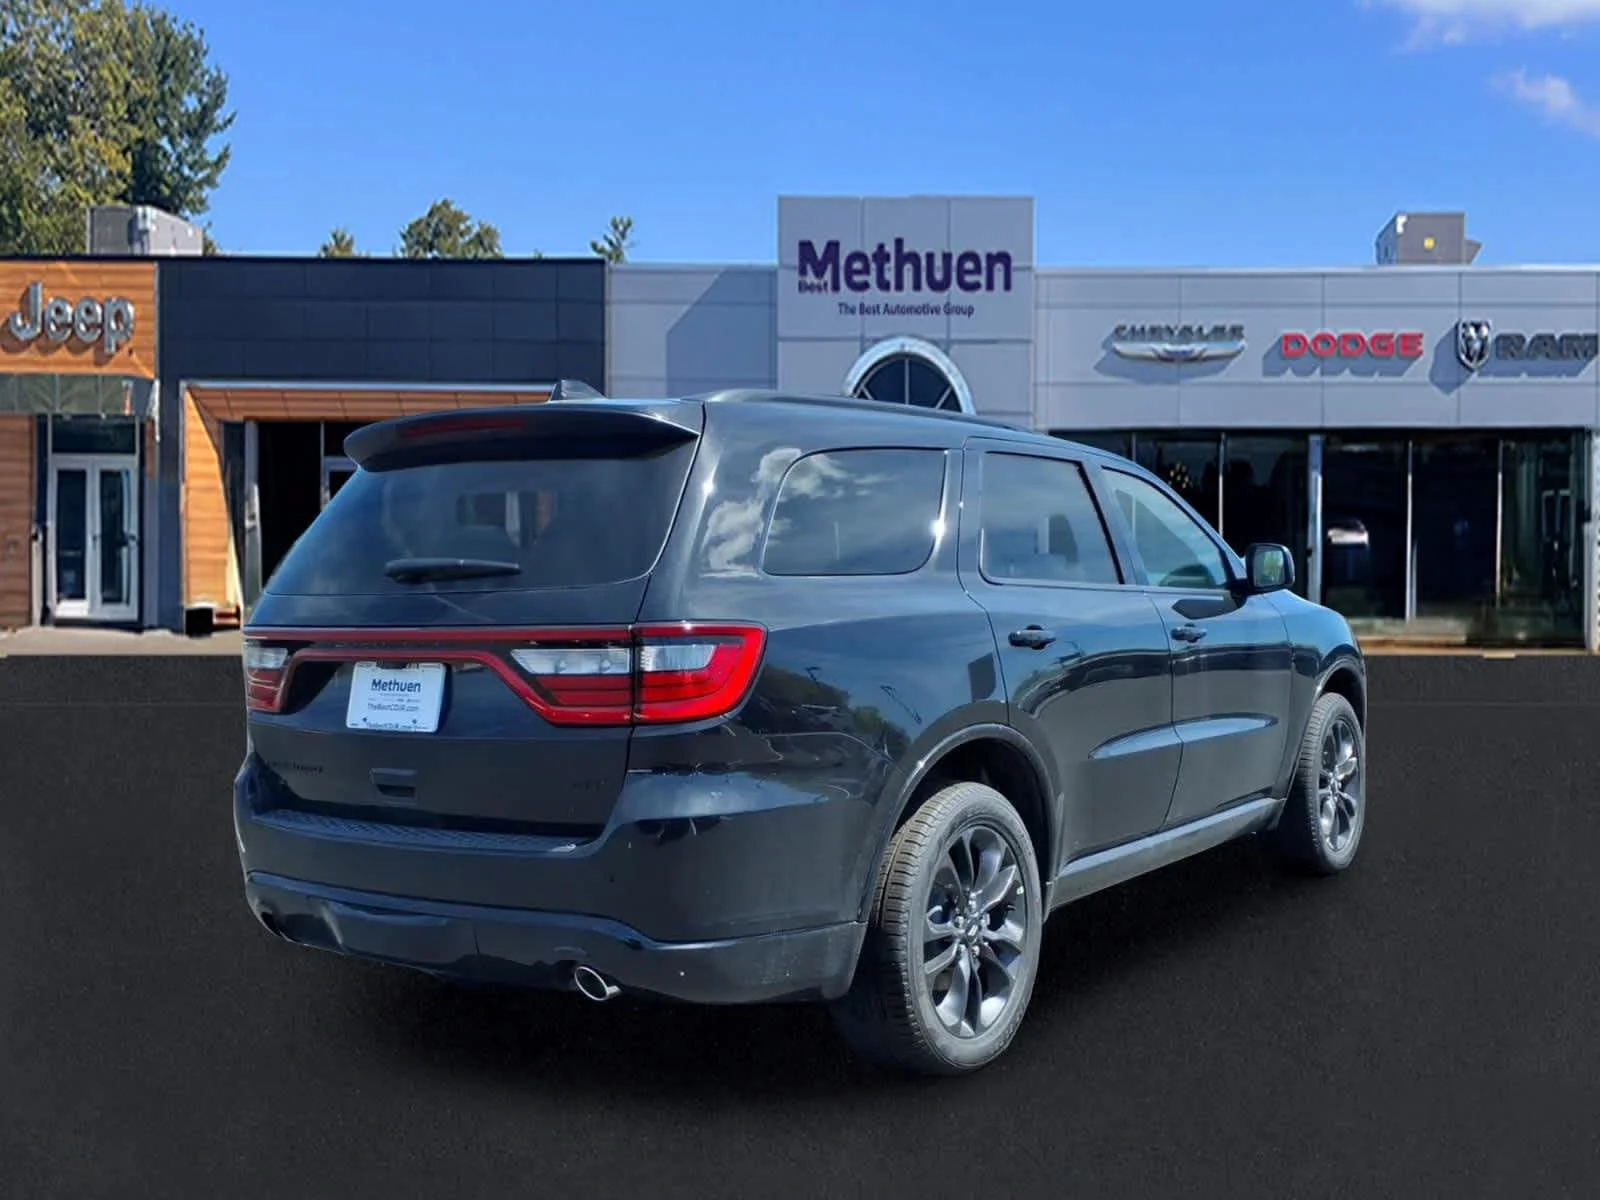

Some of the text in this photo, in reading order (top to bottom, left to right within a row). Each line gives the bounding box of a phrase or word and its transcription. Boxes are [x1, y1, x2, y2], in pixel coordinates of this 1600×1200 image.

[798, 237, 1012, 292] Methuen
[798, 280, 828, 294] Best
[9, 280, 135, 353] Jeep
[838, 302, 975, 318] The Best Automotive Group
[1114, 324, 1245, 341] CHRYSLER
[1281, 331, 1424, 358] DODGE
[1495, 333, 1599, 360] RAM
[371, 678, 422, 693] Methuen
